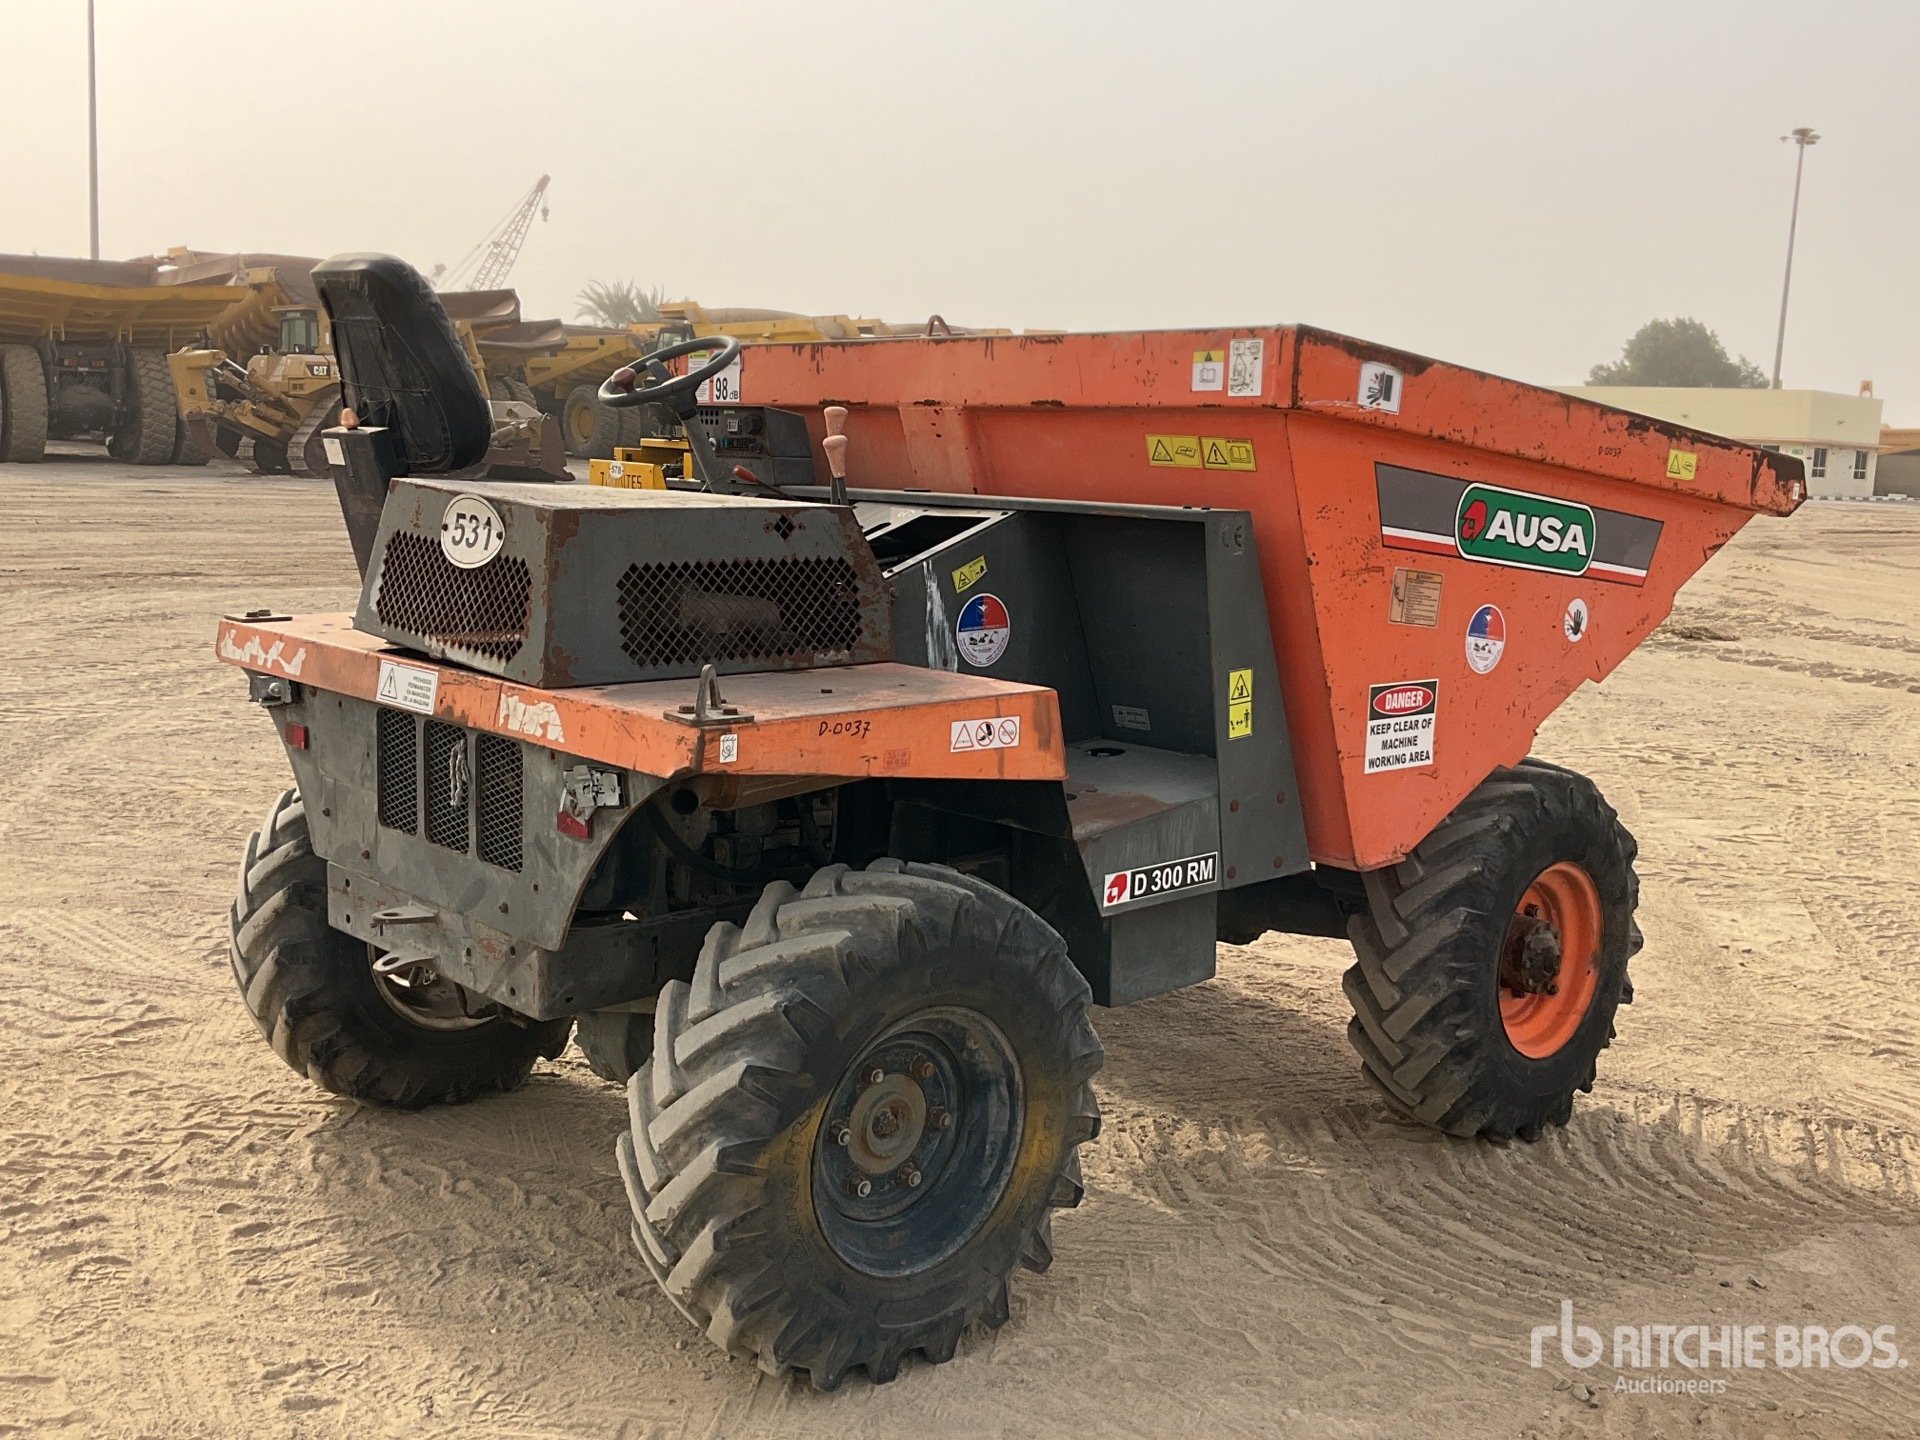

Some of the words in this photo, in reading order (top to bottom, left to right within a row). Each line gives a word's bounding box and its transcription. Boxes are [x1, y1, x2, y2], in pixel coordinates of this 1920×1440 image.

[313, 365, 328, 376] CAT
[715, 377, 728, 400] 98
[729, 390, 739, 400] dB
[611, 465, 622, 475] 578
[451, 512, 492, 551] 531
[1484, 509, 1588, 556] AUSA
[1385, 690, 1424, 711] DANGER
[1370, 723, 1391, 736] KEEP
[1393, 719, 1419, 733] CLEAR
[1421, 717, 1432, 730] OF
[1381, 735, 1418, 751] MACHINE
[1368, 753, 1407, 770] WORKING
[1408, 750, 1430, 763] AREA
[1134, 873, 1147, 896] D
[1151, 865, 1183, 892] 300
[1187, 858, 1213, 884] RM
